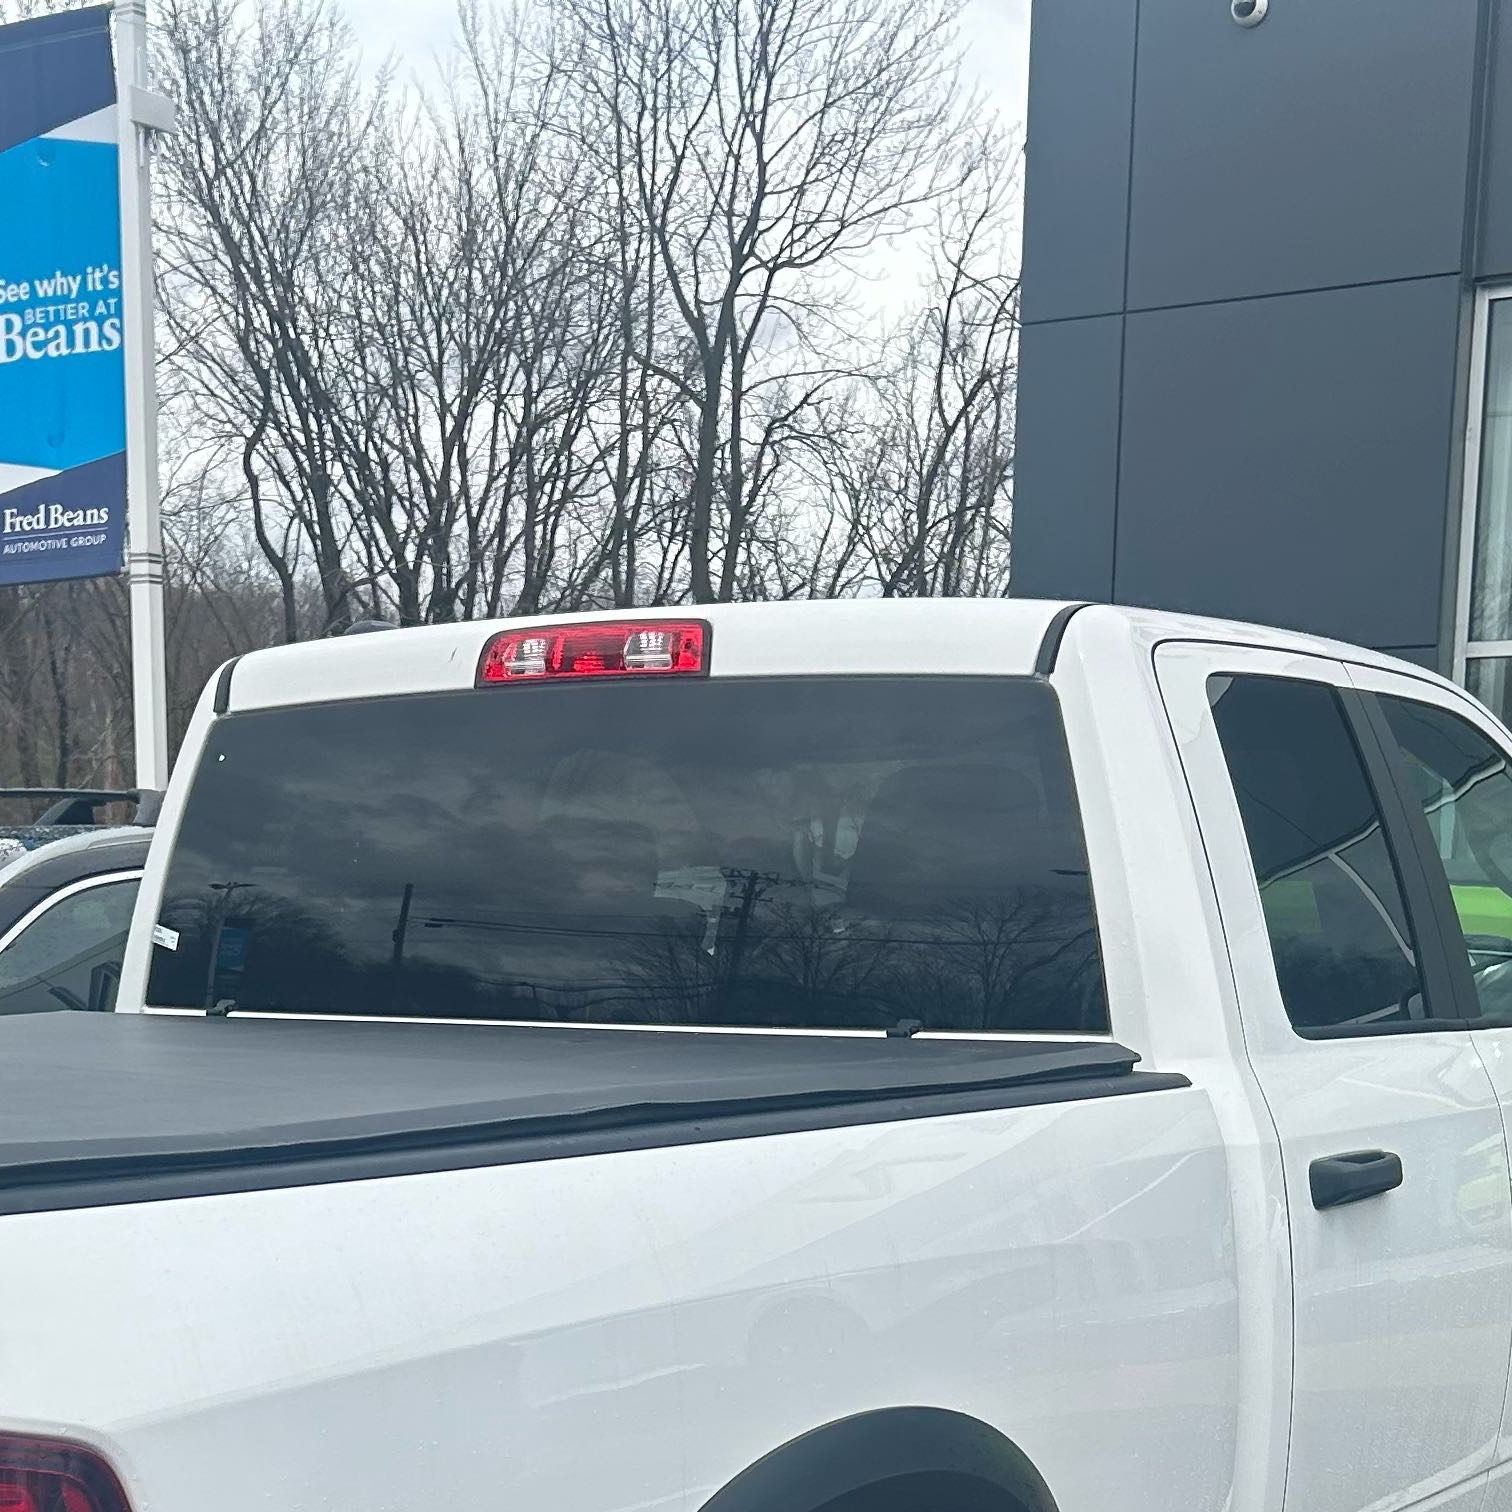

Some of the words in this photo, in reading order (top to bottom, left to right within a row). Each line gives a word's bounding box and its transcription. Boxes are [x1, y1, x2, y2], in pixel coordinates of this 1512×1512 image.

[34, 270, 82, 299] why
[86, 263, 120, 291] it's
[24, 302, 89, 325] BETTER
[94, 298, 118, 316] AT
[2, 504, 46, 533] Fred
[48, 504, 109, 528] Beans
[2, 538, 68, 555] AUTOMOTIVE
[70, 534, 107, 548] GROUP
